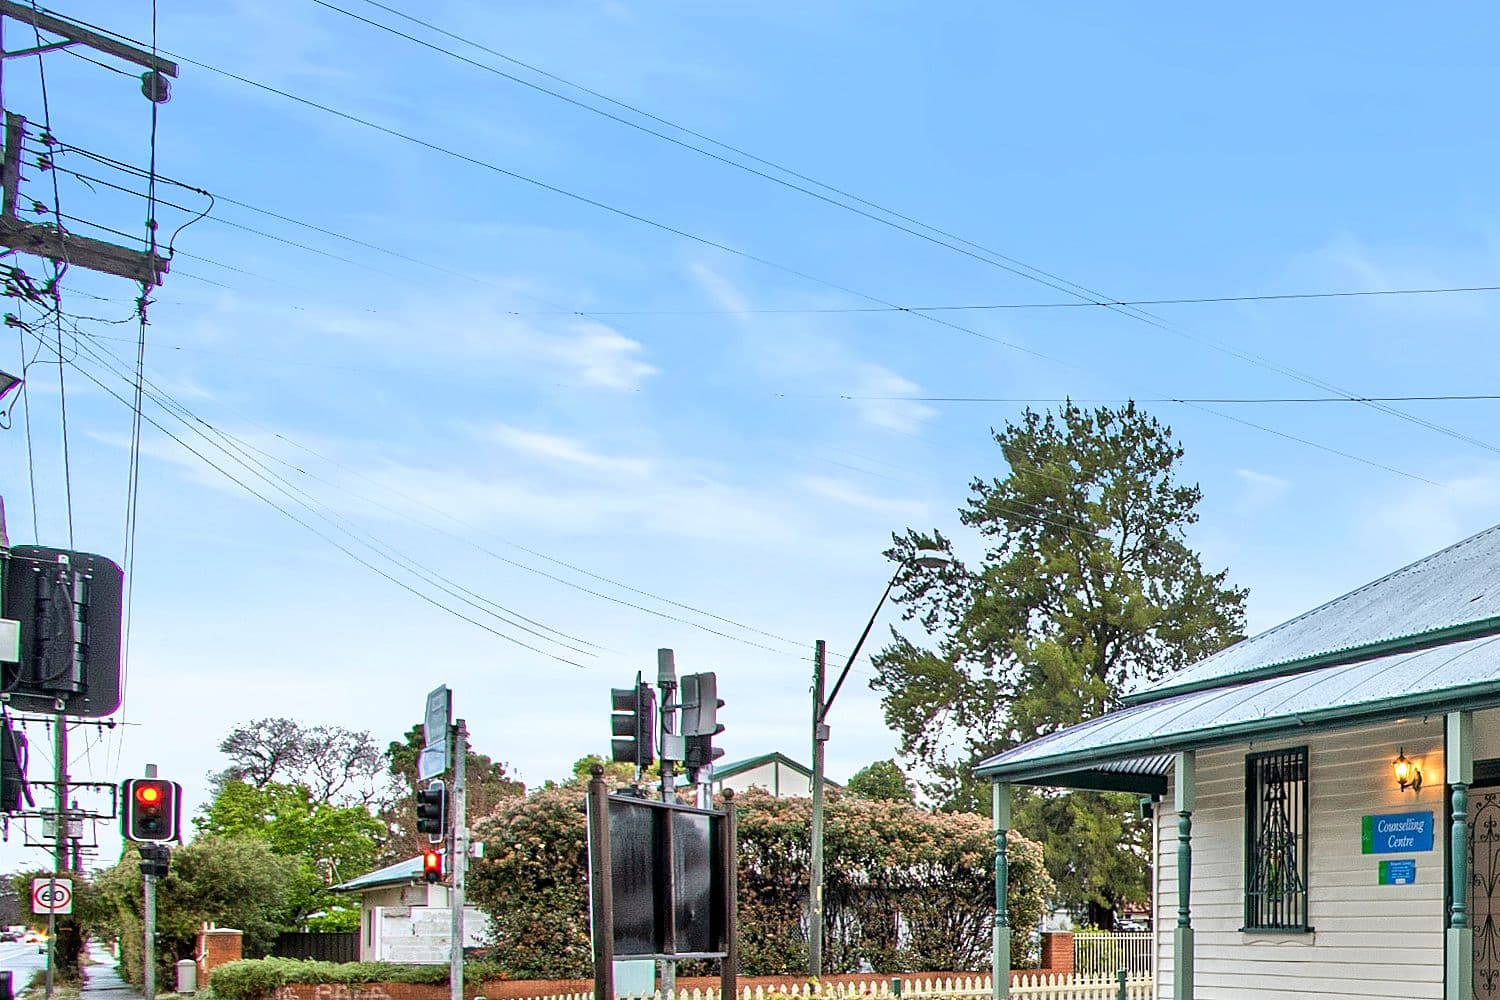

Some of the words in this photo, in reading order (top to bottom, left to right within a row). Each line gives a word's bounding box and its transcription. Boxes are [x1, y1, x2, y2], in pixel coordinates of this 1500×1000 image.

[1378, 817, 1425, 833] Counselling
[1388, 834, 1414, 848] Centre
[42, 890, 64, 902] 60
